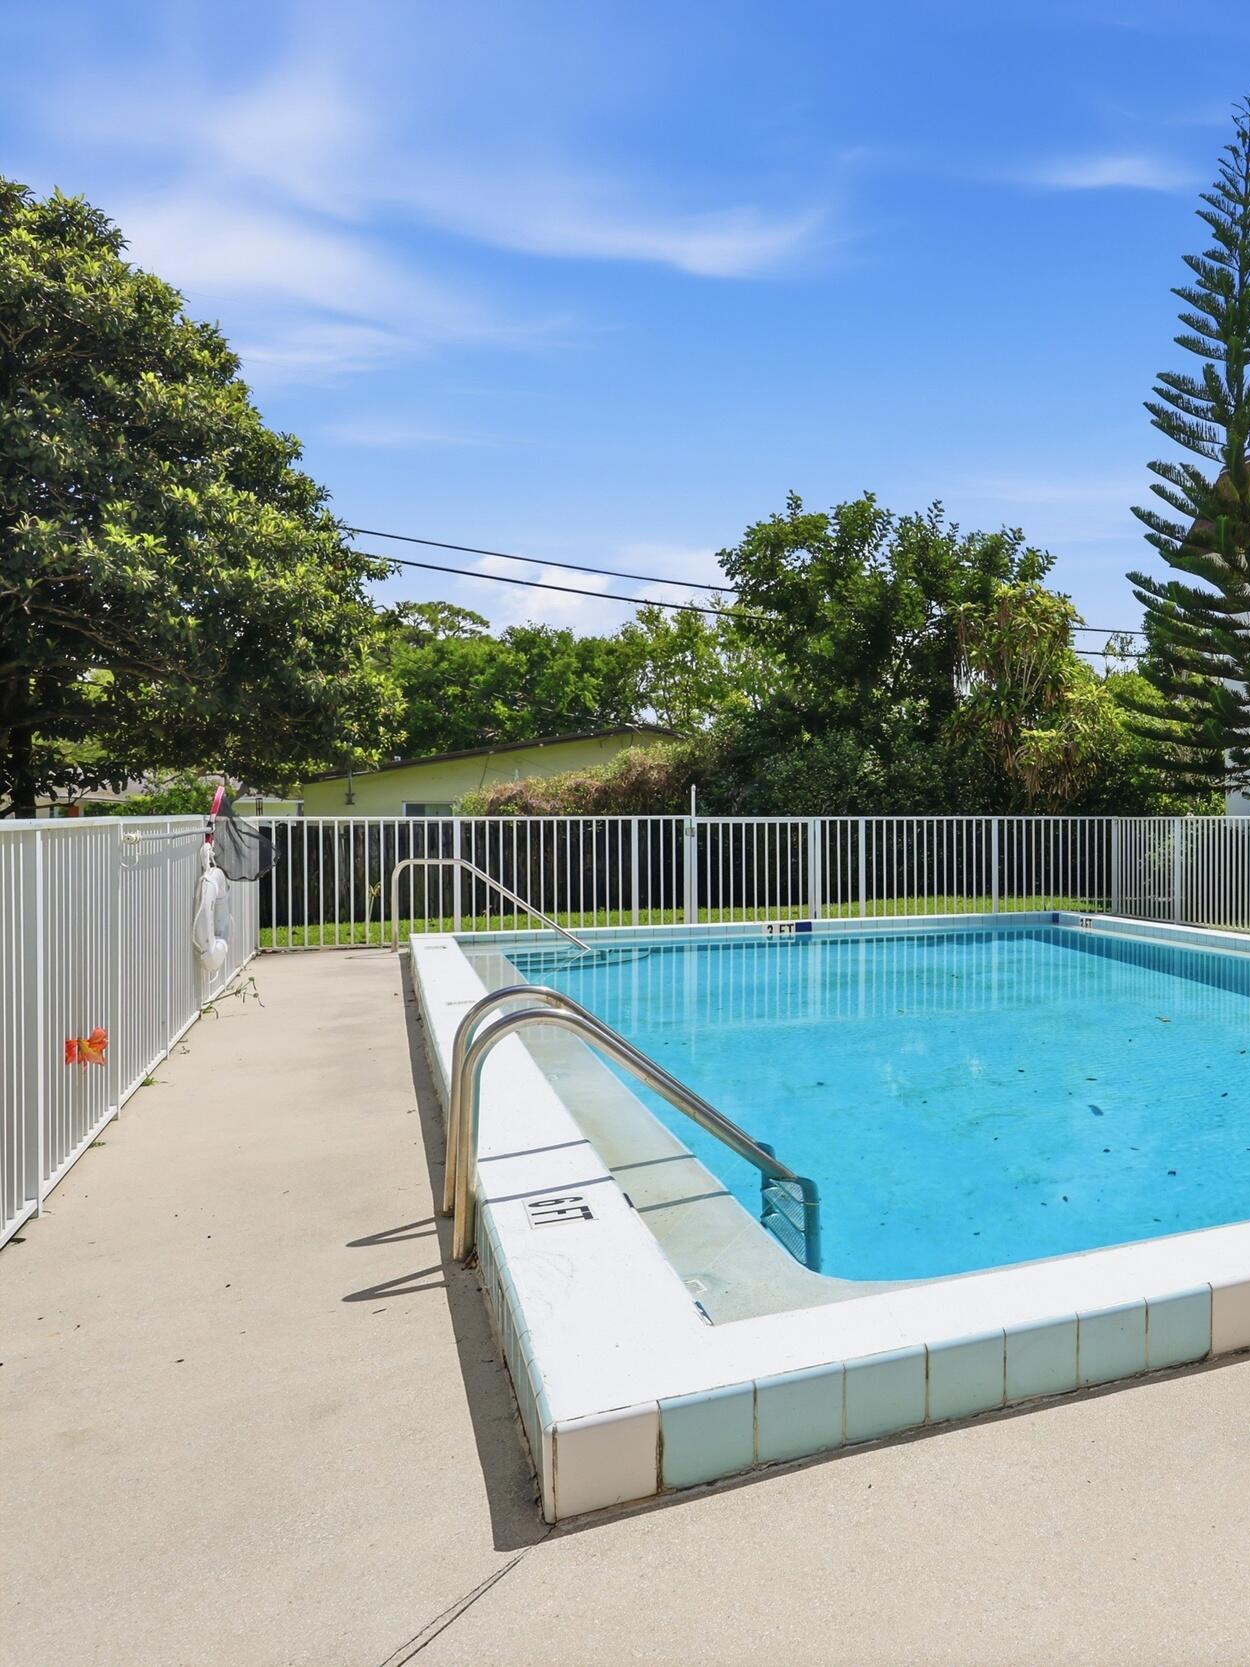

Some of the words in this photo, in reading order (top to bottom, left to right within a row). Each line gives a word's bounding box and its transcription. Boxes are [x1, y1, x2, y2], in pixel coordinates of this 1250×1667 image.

[779, 923, 794, 934] FT
[528, 1196, 583, 1207] 6
[531, 1206, 594, 1225] FT
